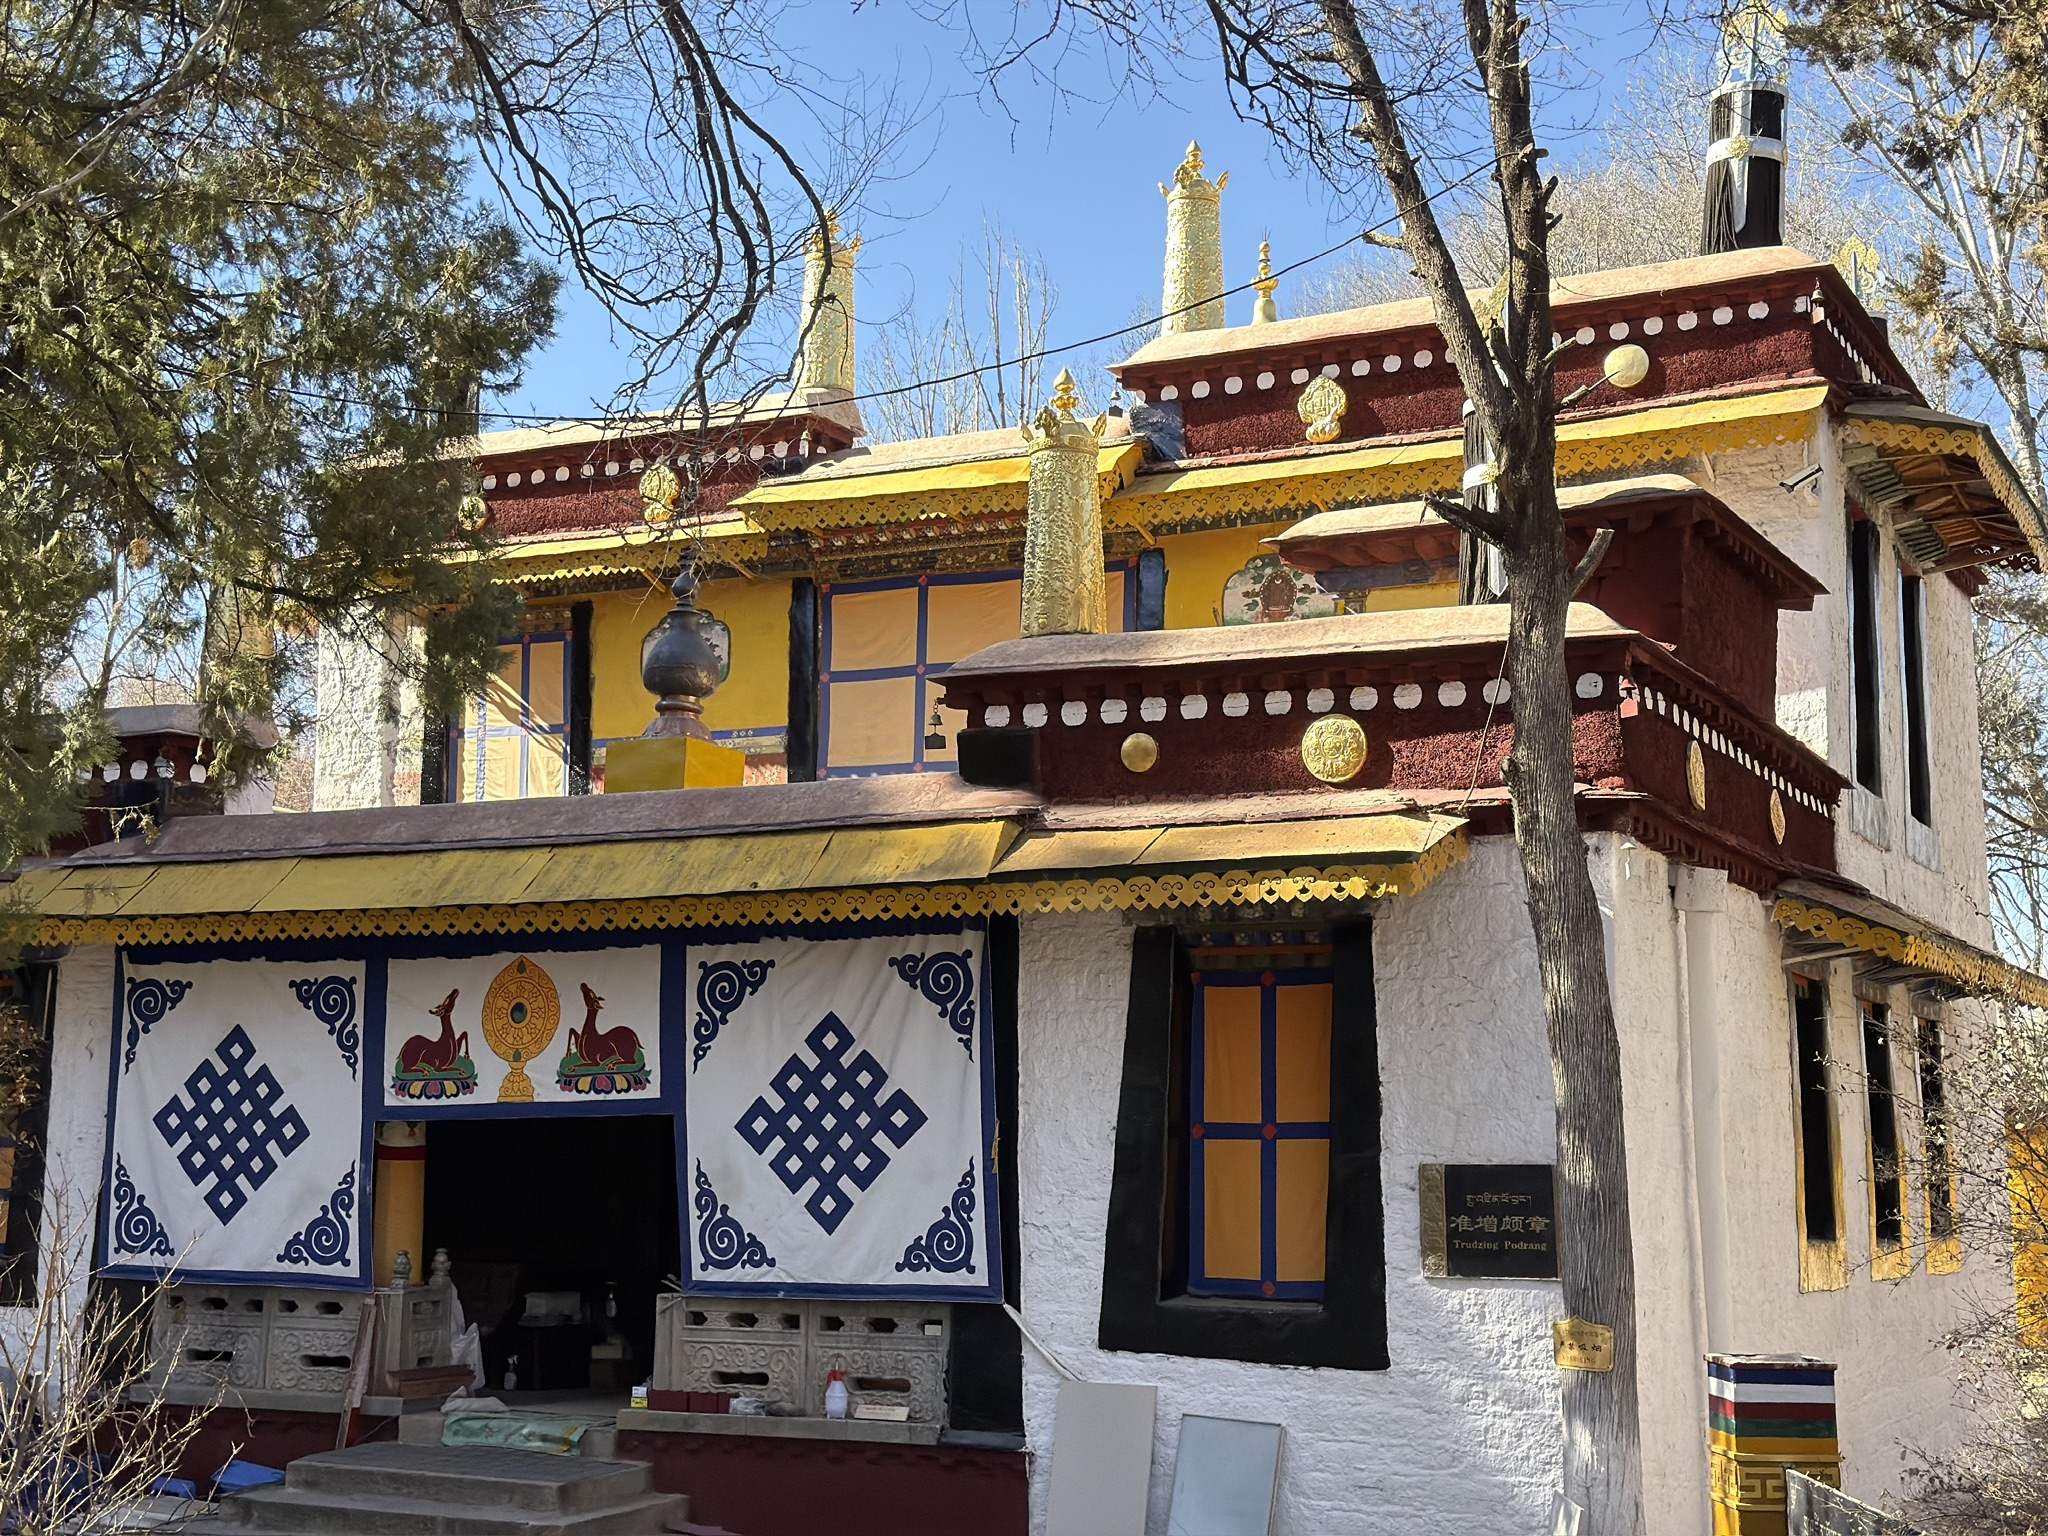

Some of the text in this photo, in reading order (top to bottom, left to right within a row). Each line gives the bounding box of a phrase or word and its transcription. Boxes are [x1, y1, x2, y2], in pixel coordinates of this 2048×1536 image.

[1449, 1214, 1550, 1233] 准增颇章
[1453, 1240, 1547, 1252] Trudzing Podrang
